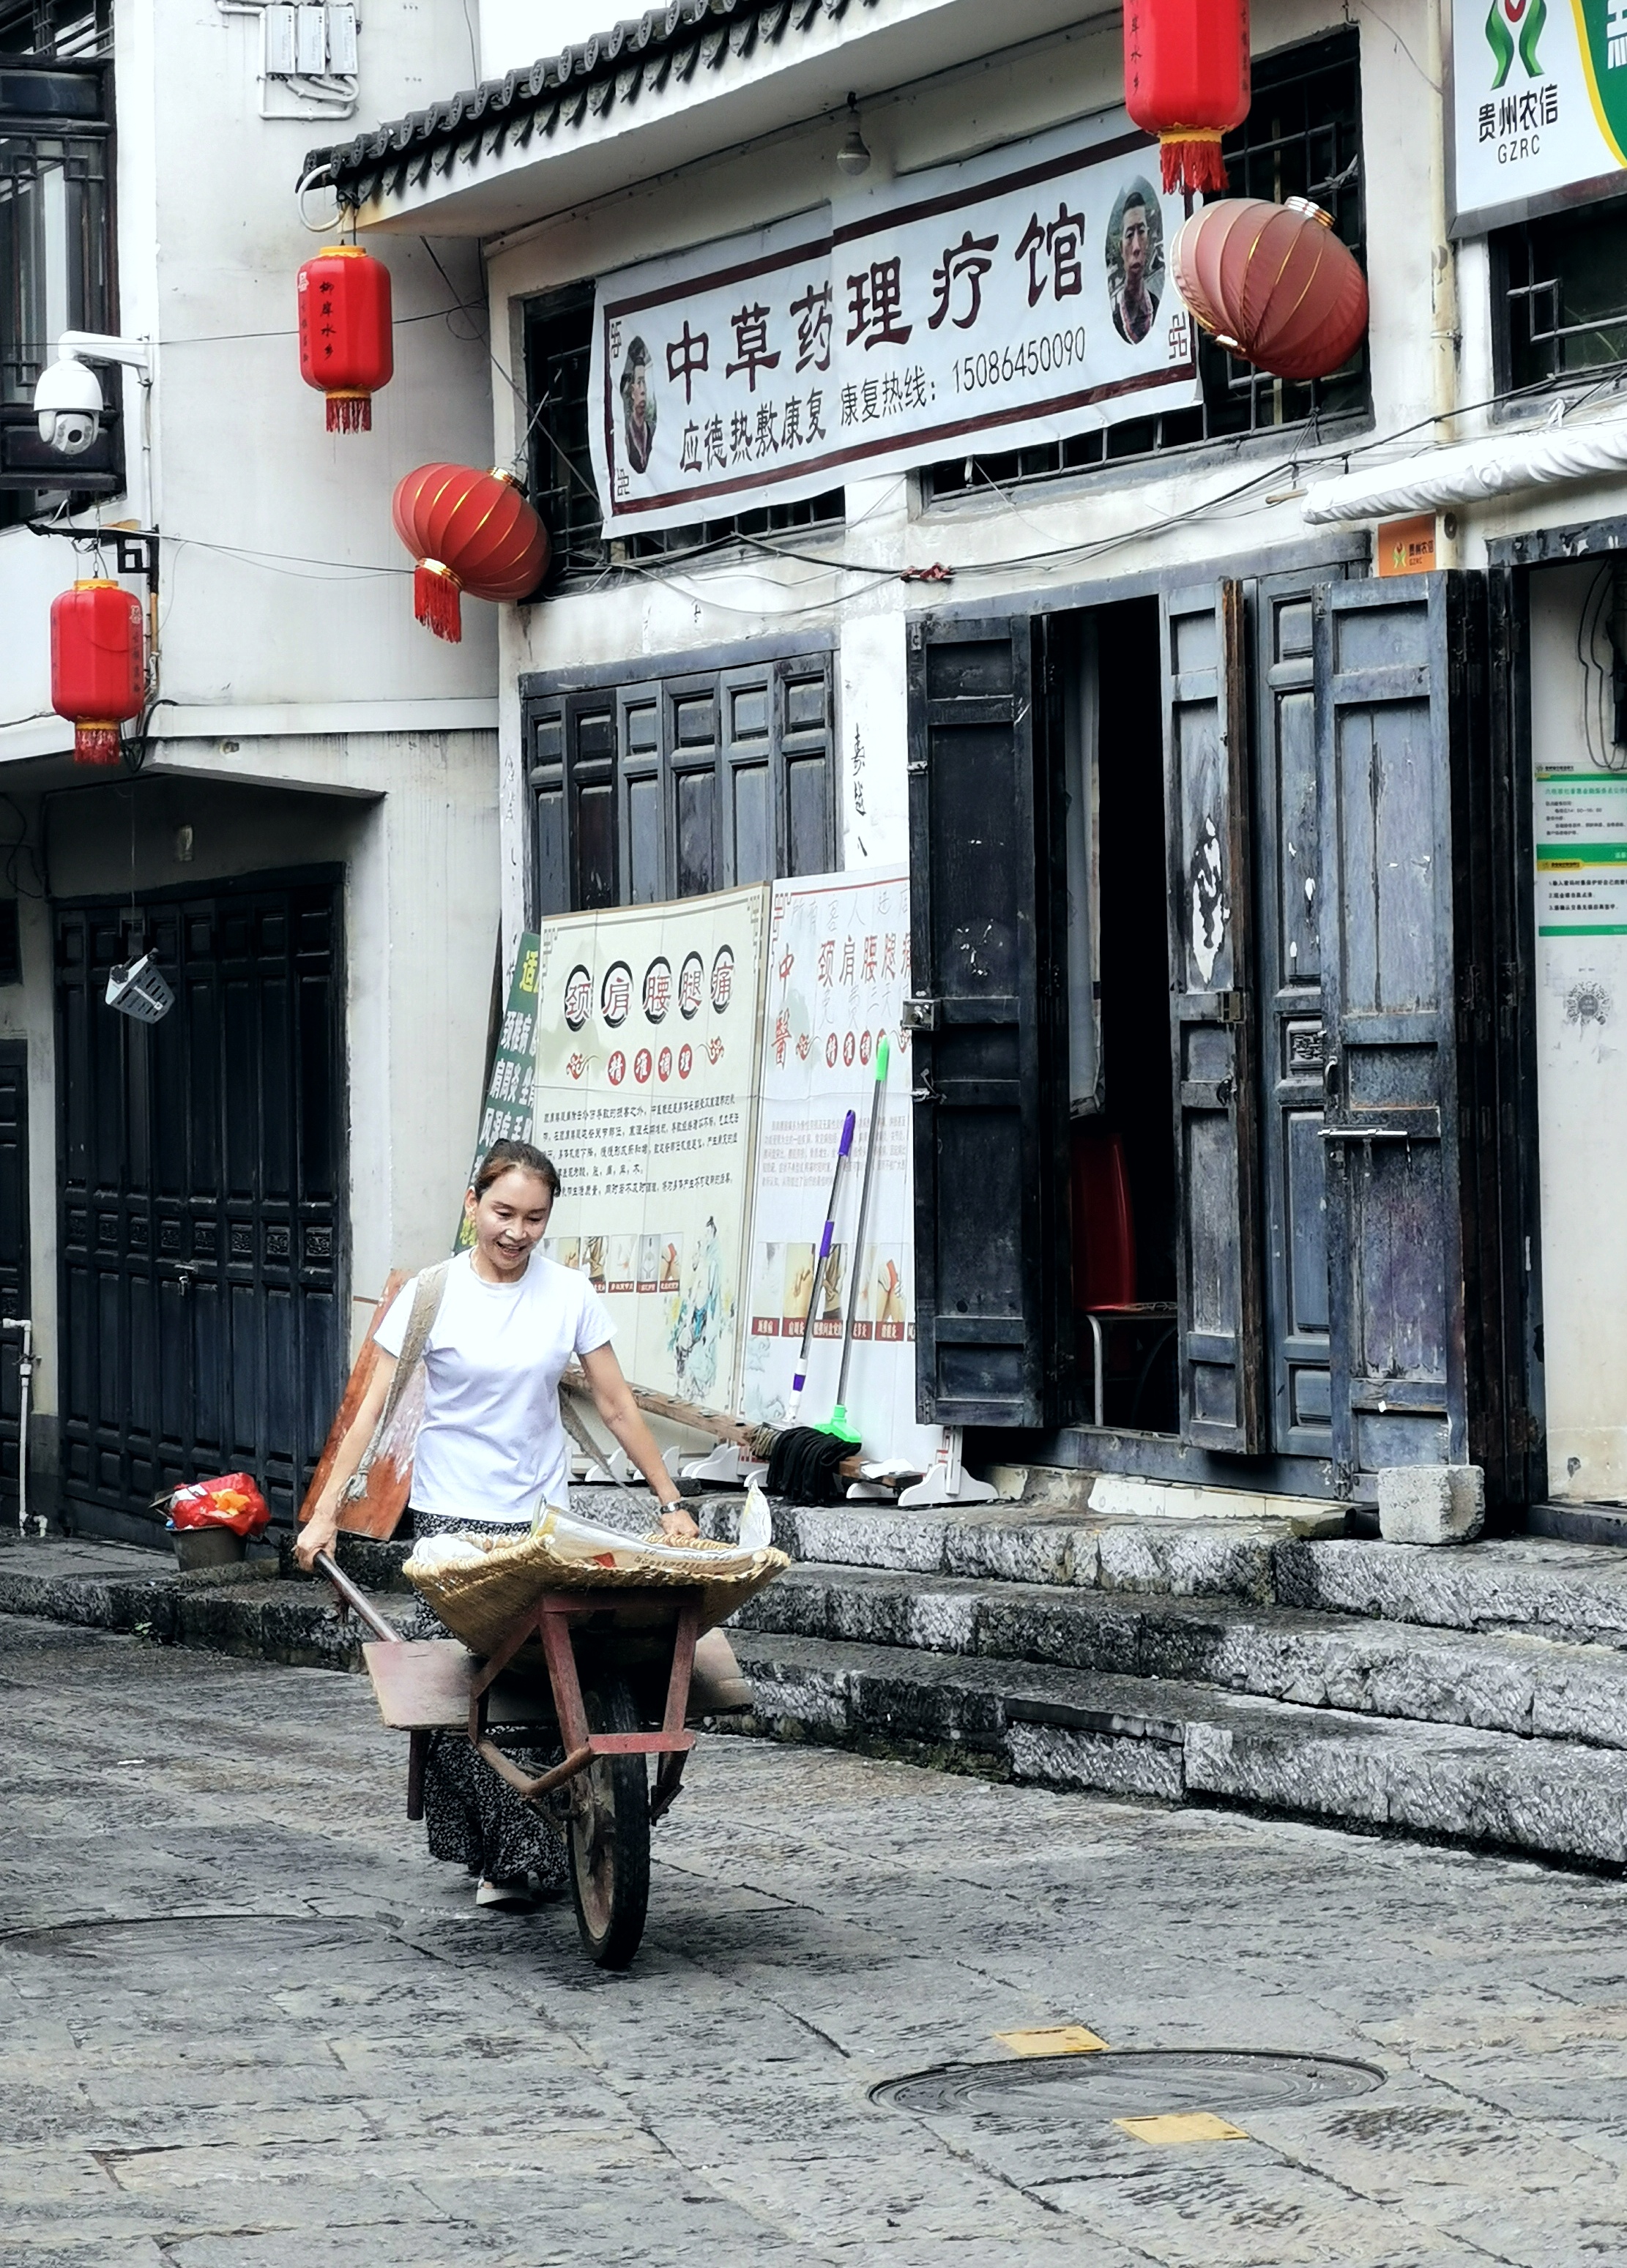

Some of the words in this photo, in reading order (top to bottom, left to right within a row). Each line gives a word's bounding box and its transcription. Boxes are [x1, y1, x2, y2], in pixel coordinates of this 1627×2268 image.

[1478, 83, 1558, 143] 贵州农信
[1497, 134, 1540, 164] GZRC
[666, 202, 1086, 404] 中草药理疗馆
[680, 387, 827, 473] 应德热敷康复
[952, 326, 1087, 394] 15086450090
[565, 953, 735, 1023] 颈肩腰腿痛
